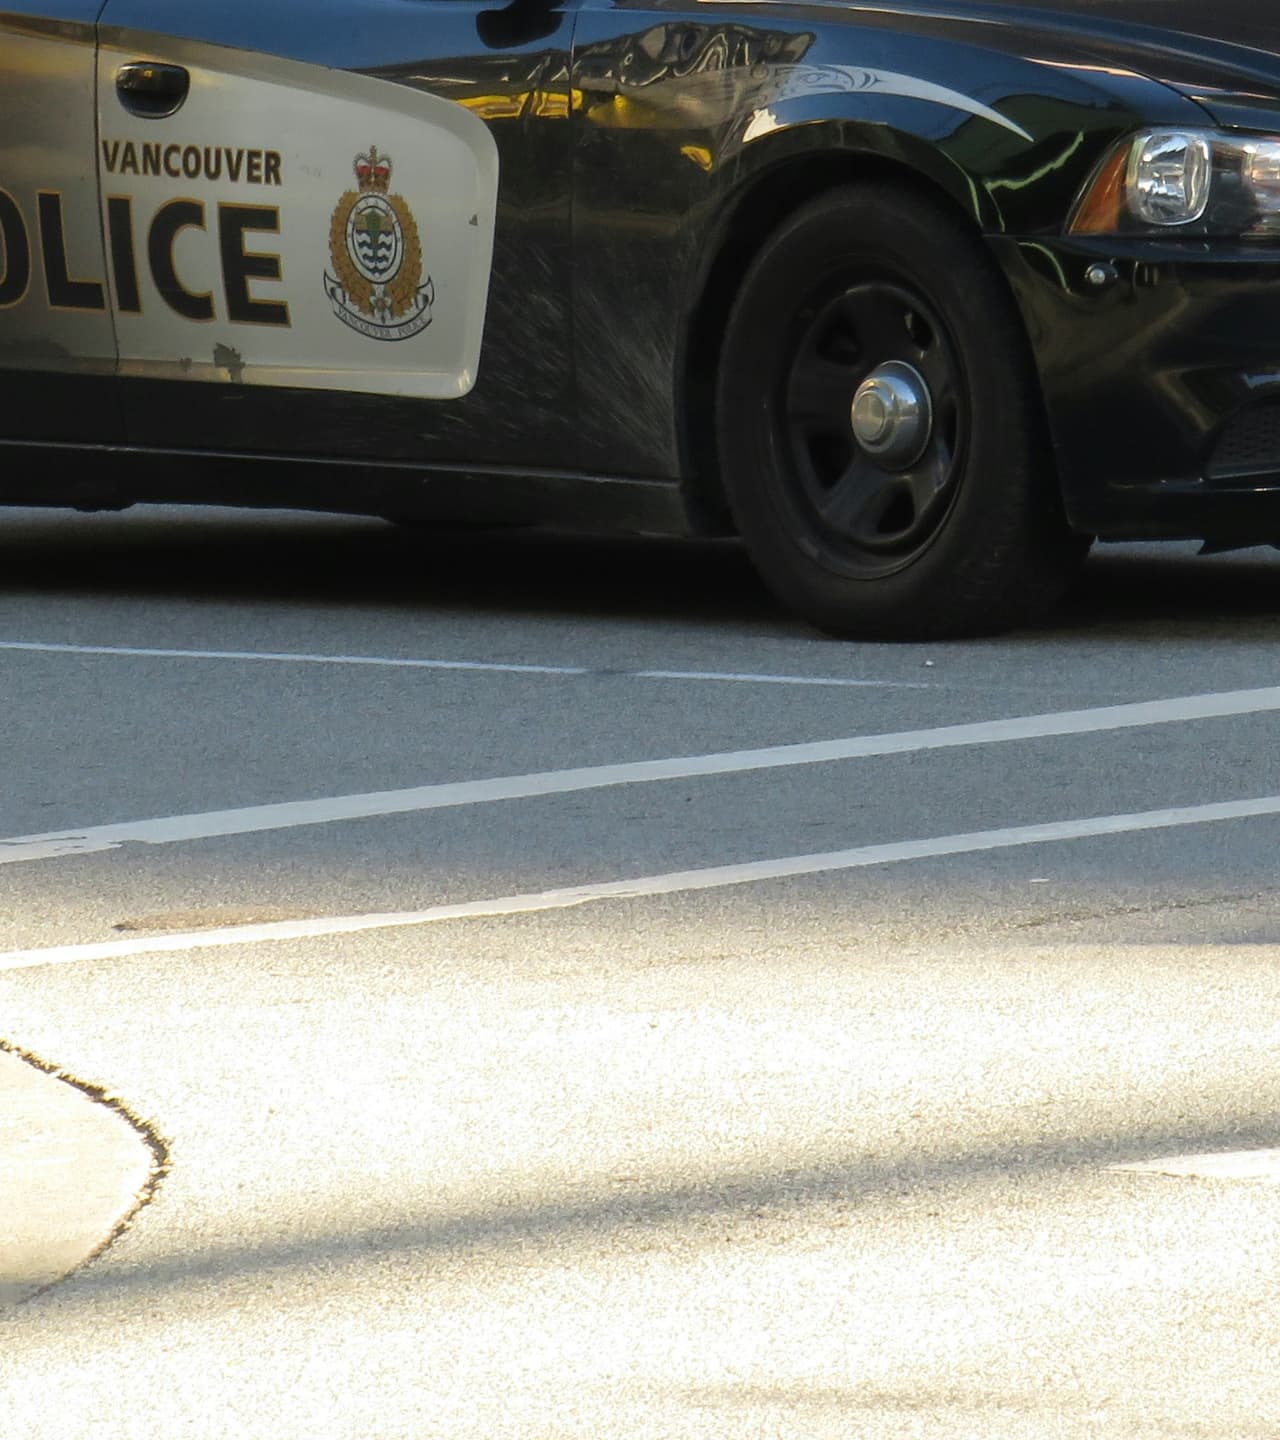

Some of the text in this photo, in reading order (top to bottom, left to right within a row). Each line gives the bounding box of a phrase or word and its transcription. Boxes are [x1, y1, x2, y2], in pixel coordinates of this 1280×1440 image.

[102, 140, 282, 186] VANCOUVER
[337, 307, 427, 338] VANCOUVER POLICE
